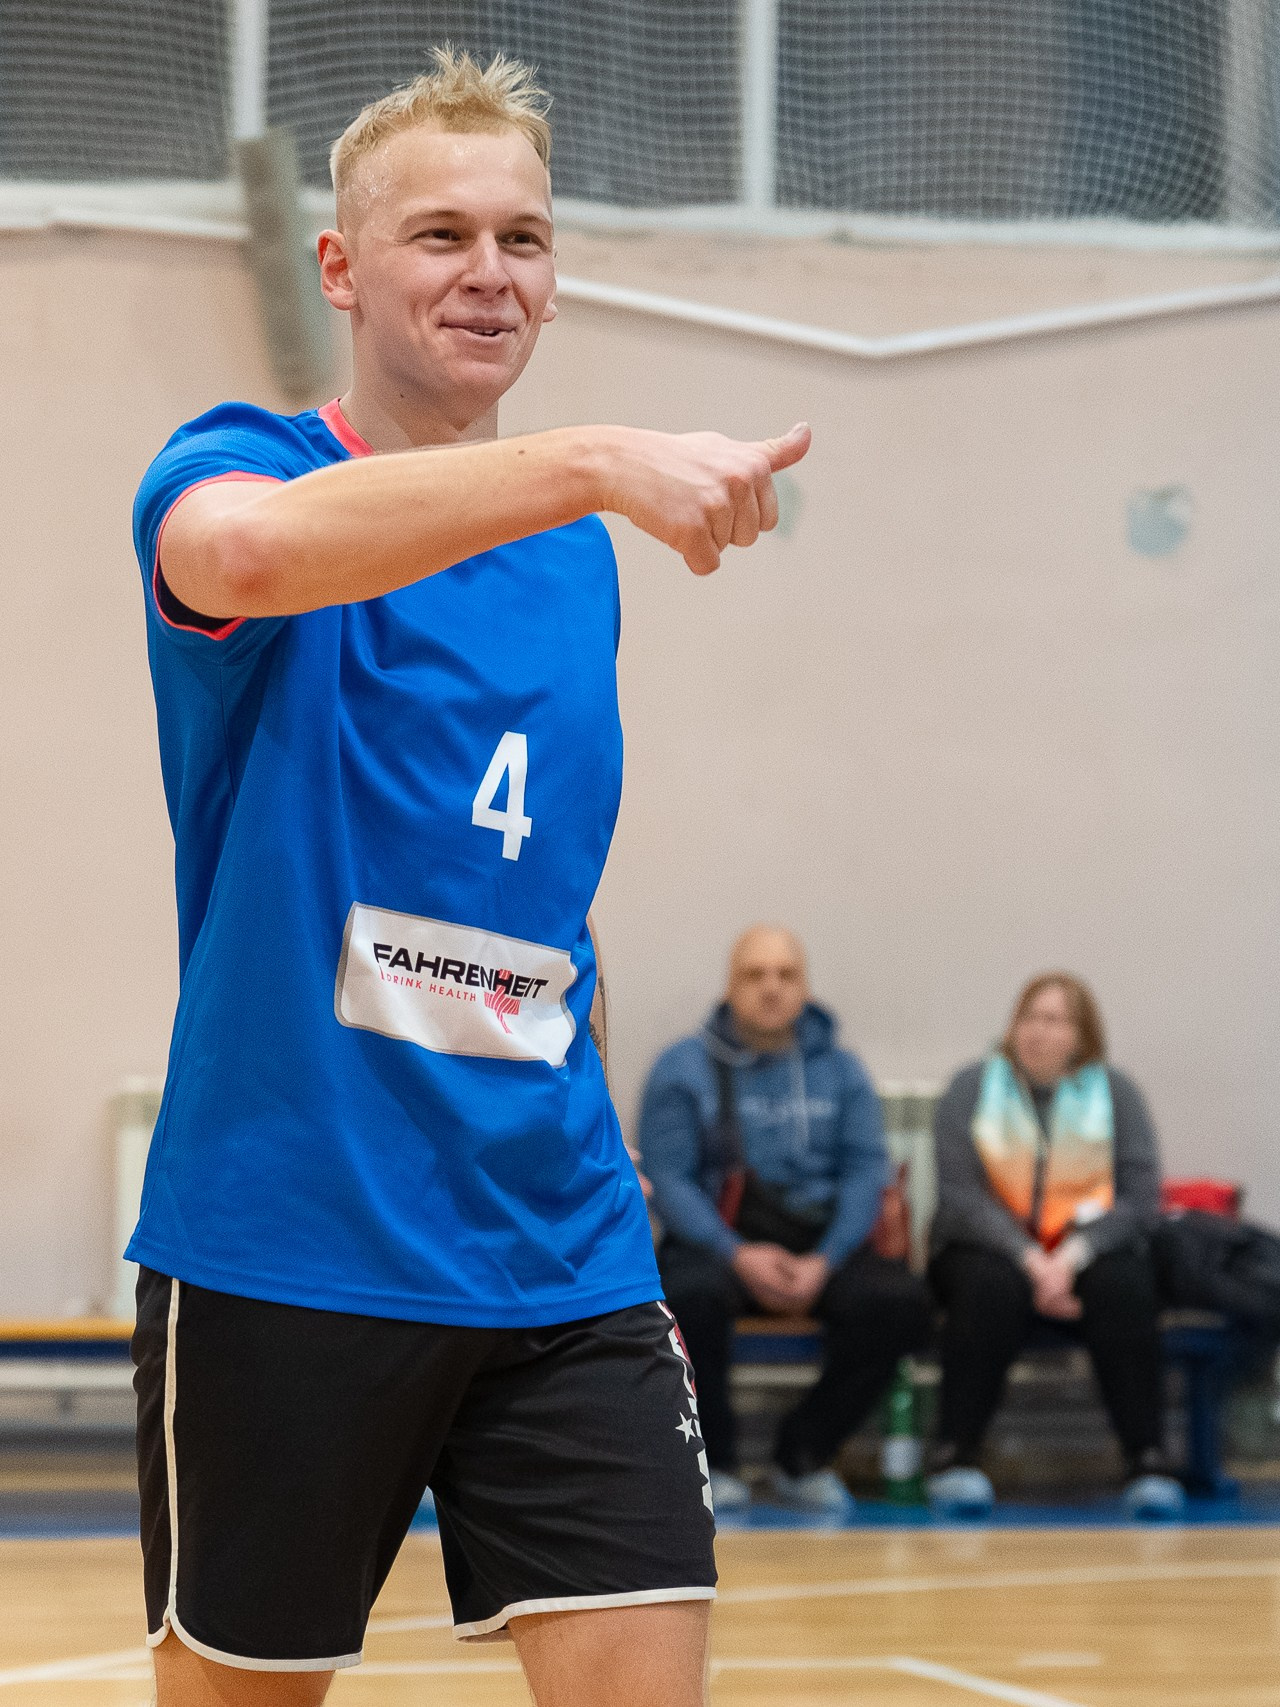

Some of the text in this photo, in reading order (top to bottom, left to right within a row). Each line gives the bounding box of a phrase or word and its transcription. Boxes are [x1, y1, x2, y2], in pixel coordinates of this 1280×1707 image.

[472, 731, 532, 861] 4
[373, 942, 549, 999] FAHRENHEIT
[386, 973, 477, 1002] DRINK HEALTH
